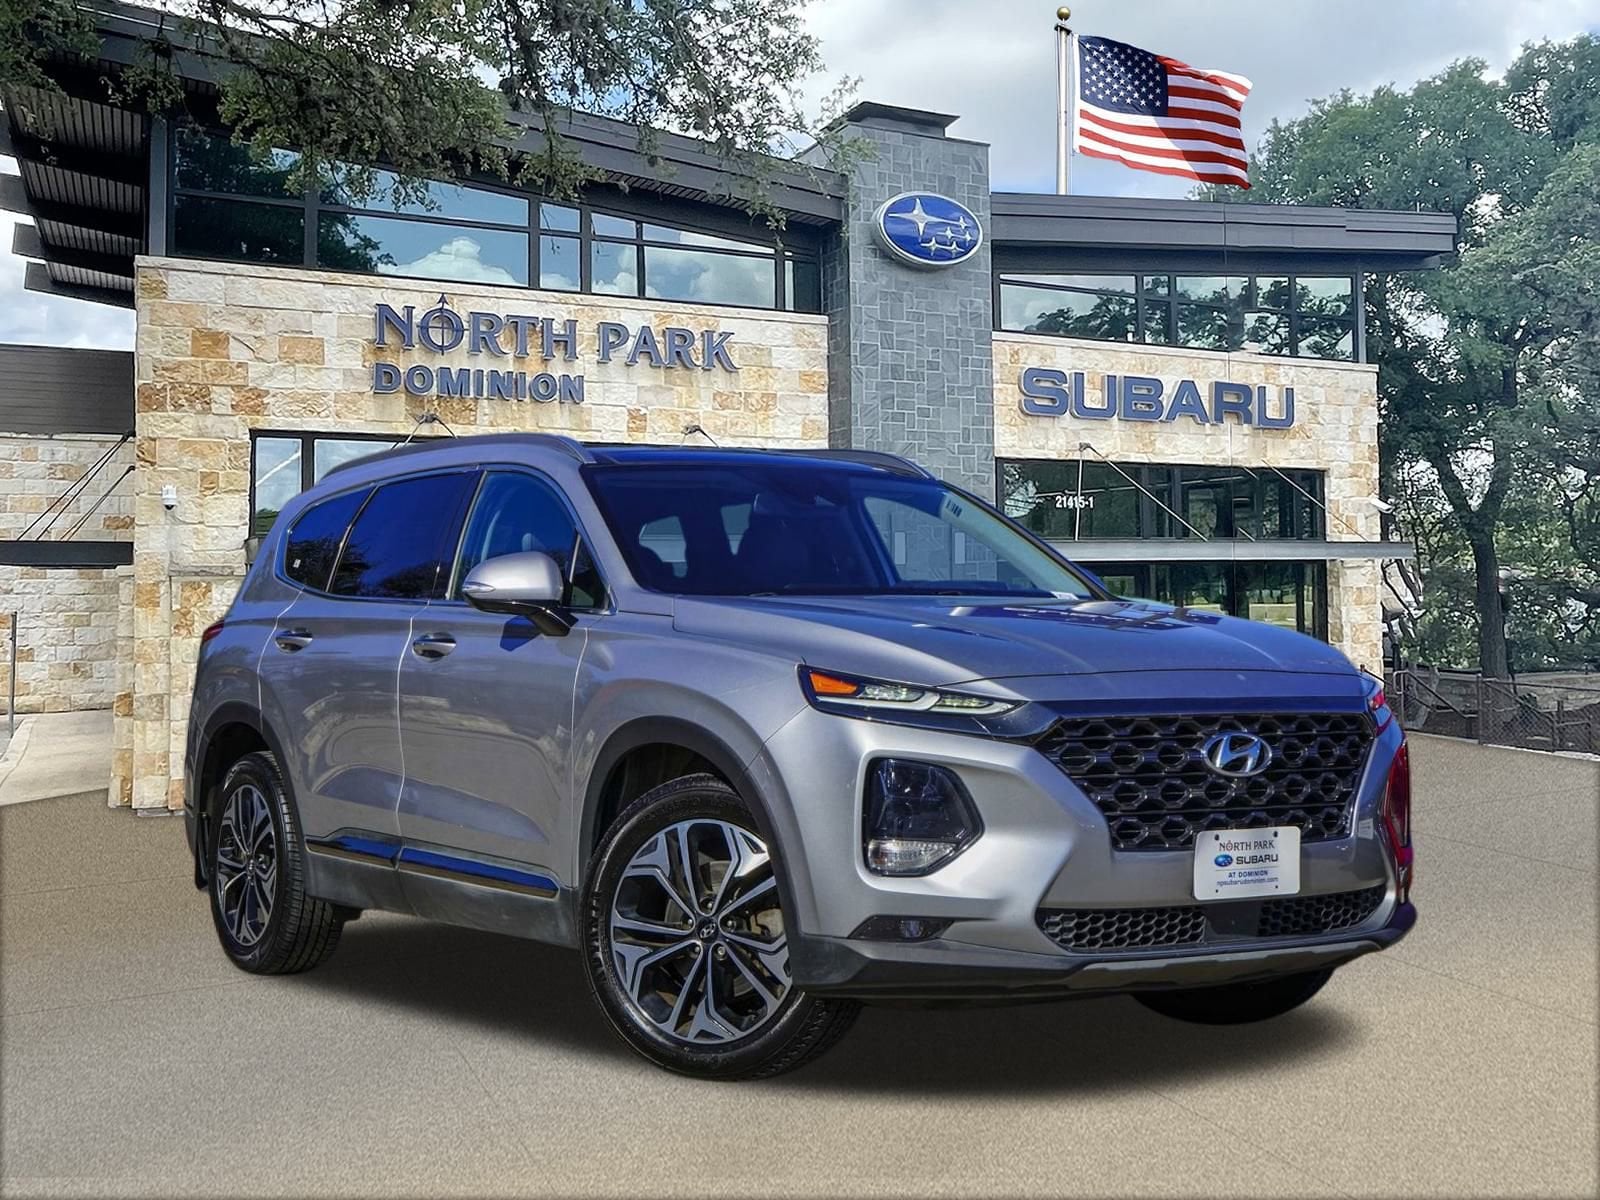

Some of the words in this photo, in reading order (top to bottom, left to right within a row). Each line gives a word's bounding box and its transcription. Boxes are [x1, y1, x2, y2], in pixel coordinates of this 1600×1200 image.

[374, 293, 579, 362] NORTH
[597, 322, 742, 373] PARK
[373, 362, 585, 404] DOMINION
[1019, 367, 1295, 430] SUBARU
[1219, 840, 1252, 852] NORTH
[1253, 840, 1275, 850] PARK
[1236, 854, 1279, 865] SUBARU
[1238, 870, 1268, 878] DOMINION
